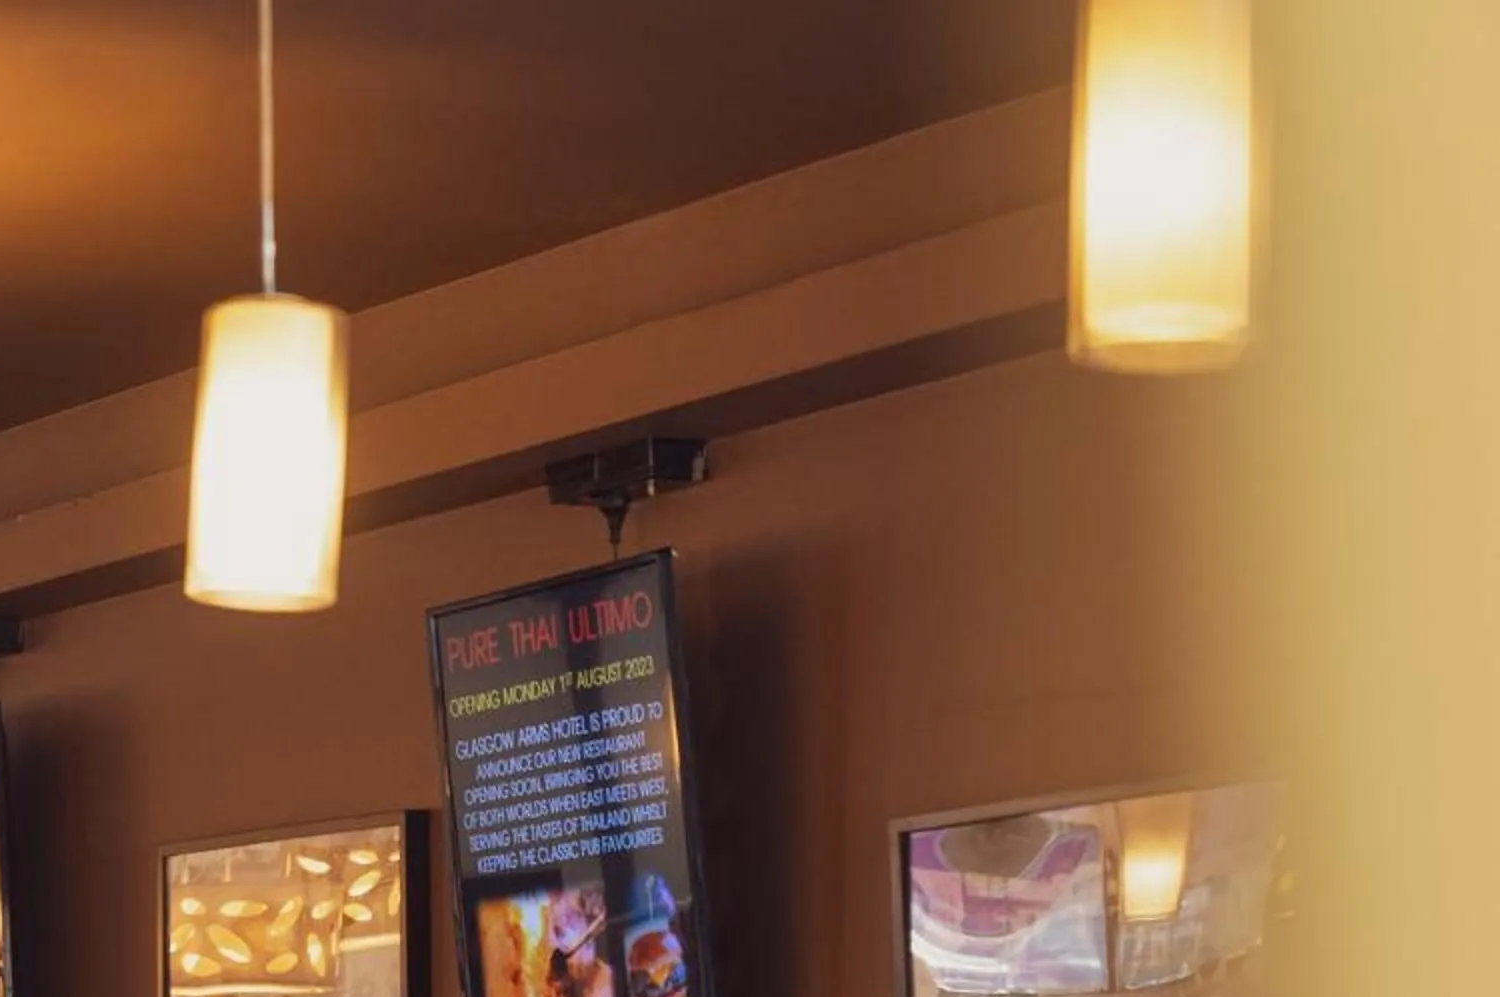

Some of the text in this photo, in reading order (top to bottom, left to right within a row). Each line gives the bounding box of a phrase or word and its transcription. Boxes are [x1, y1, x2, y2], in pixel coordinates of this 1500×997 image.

[446, 591, 653, 673] PURE THAI ULTIMO
[449, 689, 500, 718] OPENING
[503, 677, 555, 705] MONDAY
[576, 660, 623, 689] AUGUST
[625, 656, 654, 679] 2023
[456, 701, 663, 760] GLASGOW ARMS HOTEL IS PROUD TO
[476, 730, 645, 781] ANNOUNCE OUR NEW RESTAURANT
[464, 783, 509, 806] OPENING
[544, 765, 595, 789] BRINGING
[596, 761, 618, 780] YOU
[621, 757, 639, 775] THE
[640, 752, 663, 772] BEST
[463, 812, 480, 830] OF
[480, 808, 504, 828] BOTH
[505, 799, 549, 821] WORLDS
[549, 793, 580, 813] WHEN
[581, 787, 604, 809] EAST
[605, 782, 638, 803] MEETS
[469, 830, 510, 853] SERVING
[511, 826, 530, 846] THE
[530, 819, 562, 843] TASTES
[564, 817, 578, 836] OF
[579, 807, 630, 832] THAILAND
[478, 826, 665, 875] KEEPING THE CLASSIC PUB FAVOURITES
